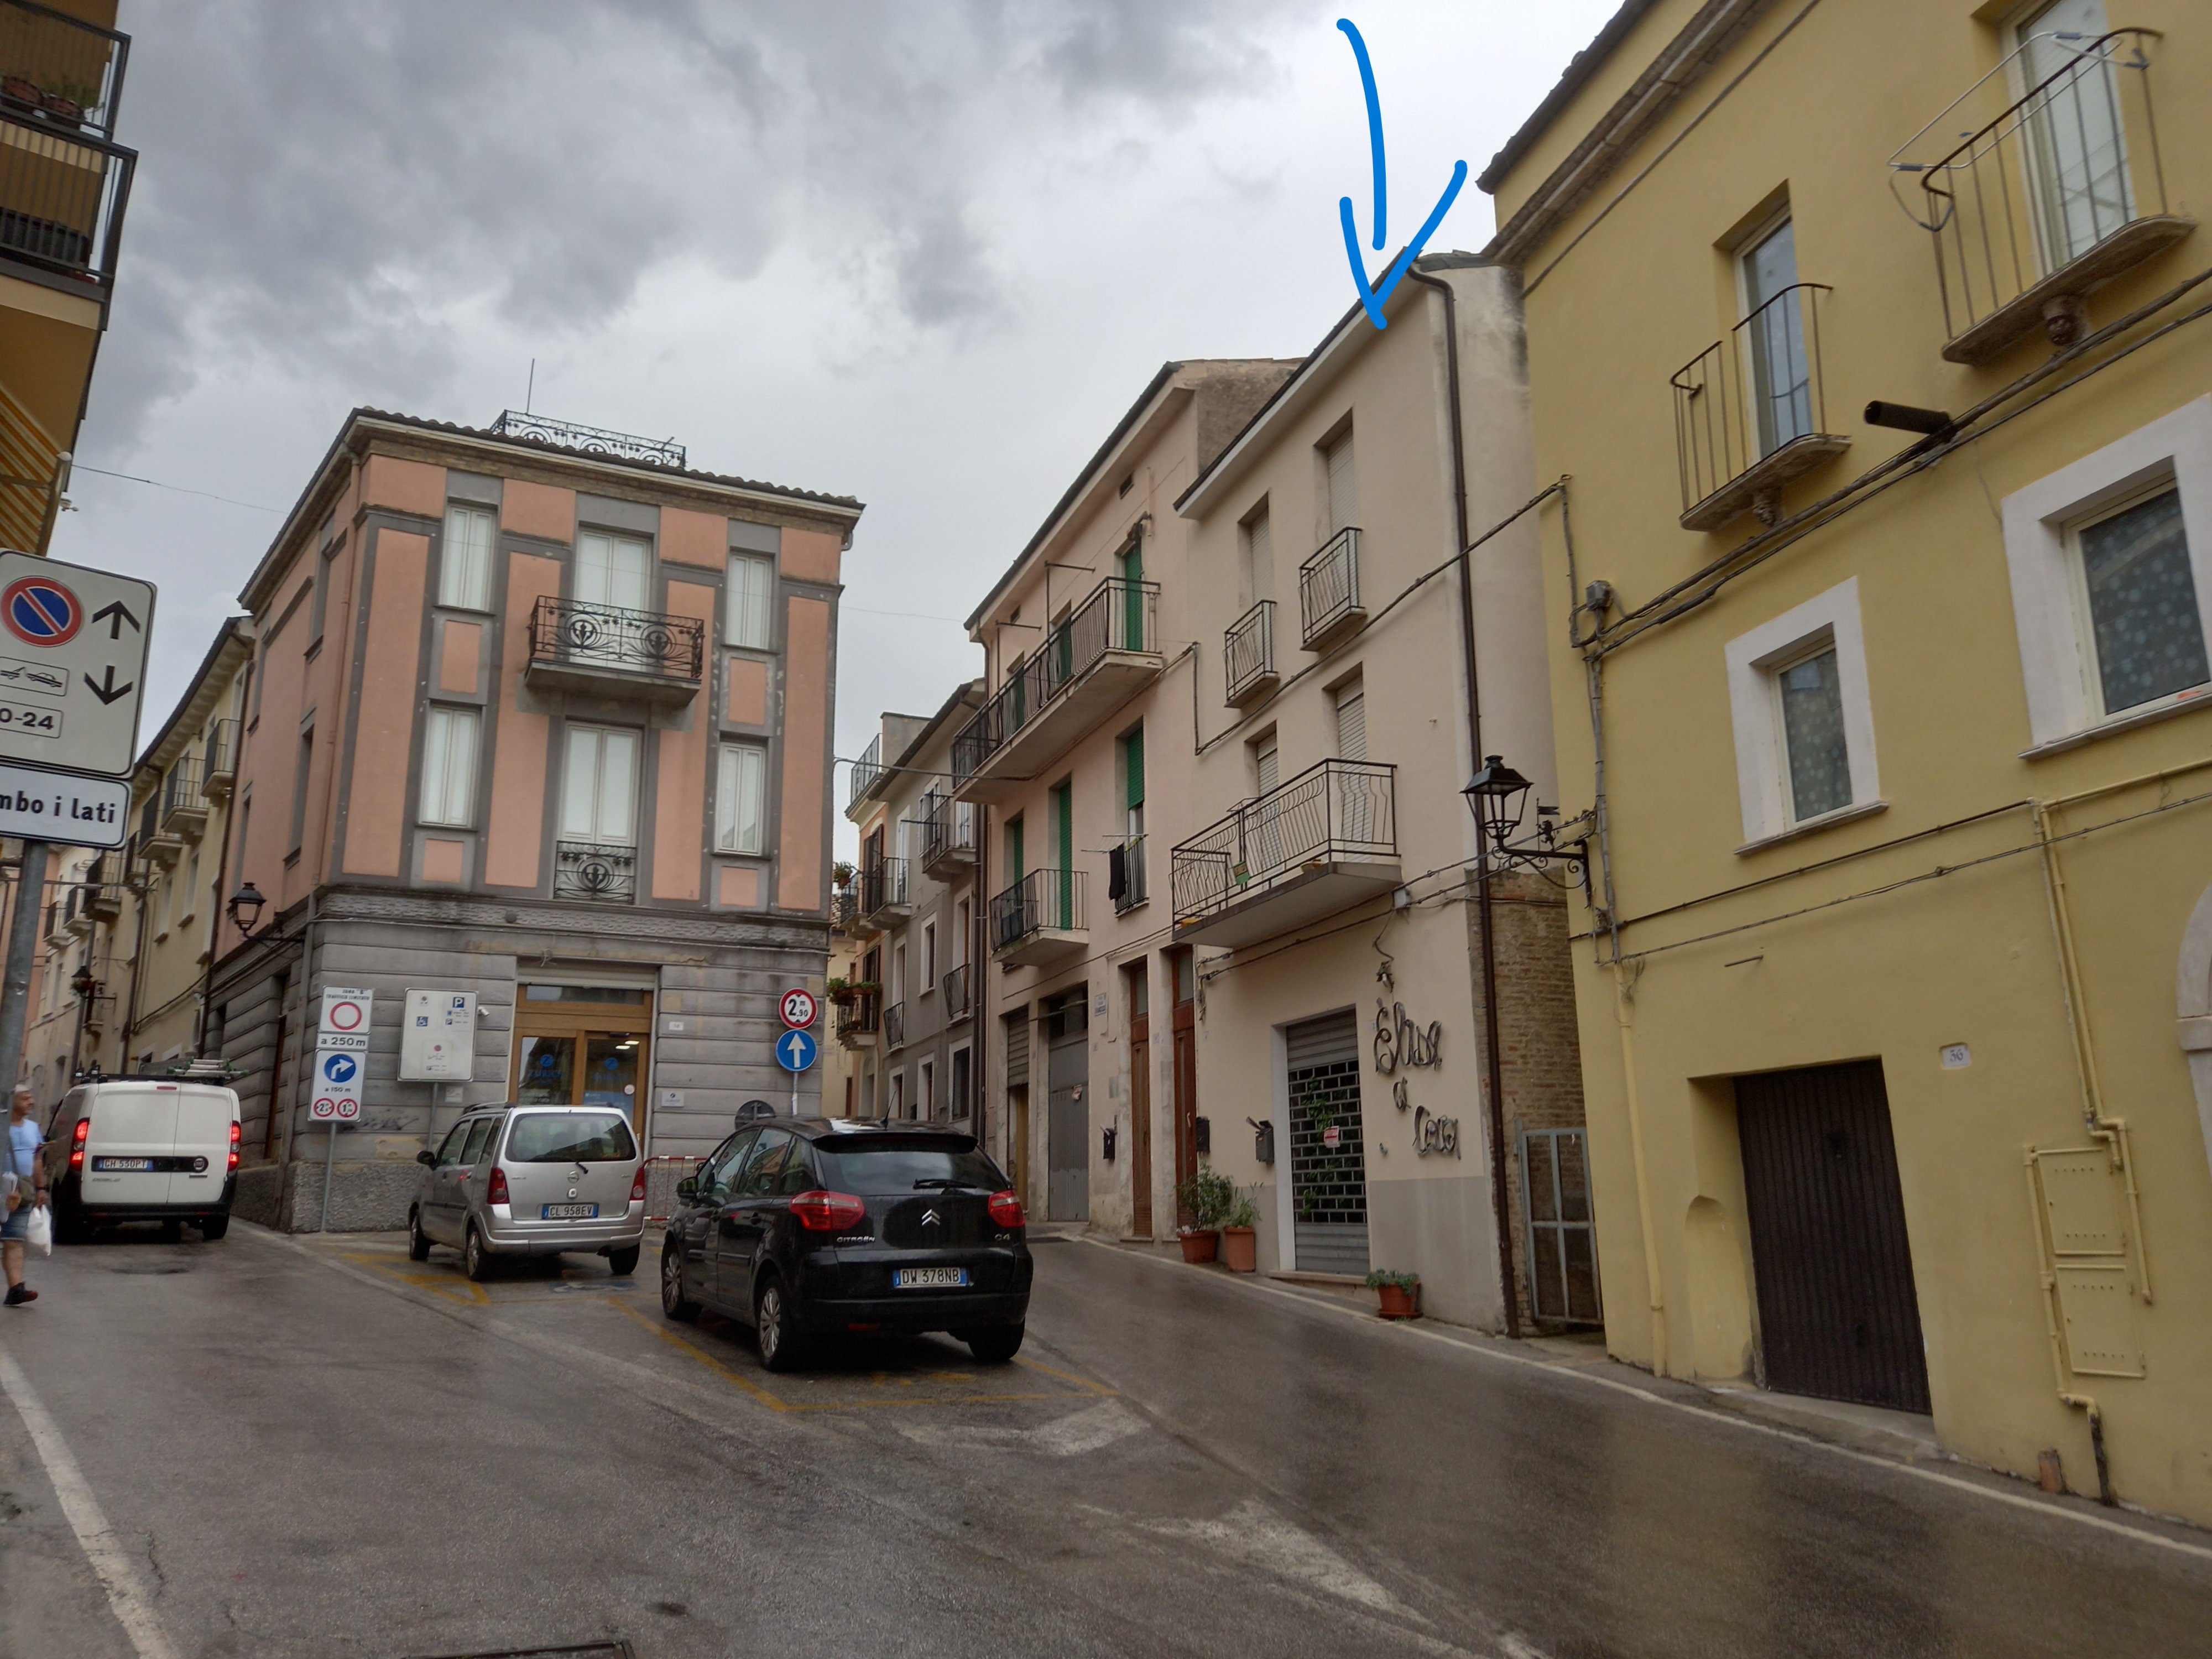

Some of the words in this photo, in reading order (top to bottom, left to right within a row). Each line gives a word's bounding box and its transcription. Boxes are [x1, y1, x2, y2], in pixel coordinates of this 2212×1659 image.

[54, 795, 62, 816] i
[71, 798, 116, 823] lati
[331, 1037, 354, 1046] 250
[550, 1207, 560, 1216] CL
[564, 1206, 592, 1215] 958EV
[902, 1270, 917, 1284] DW
[922, 1269, 959, 1282] 378NB
